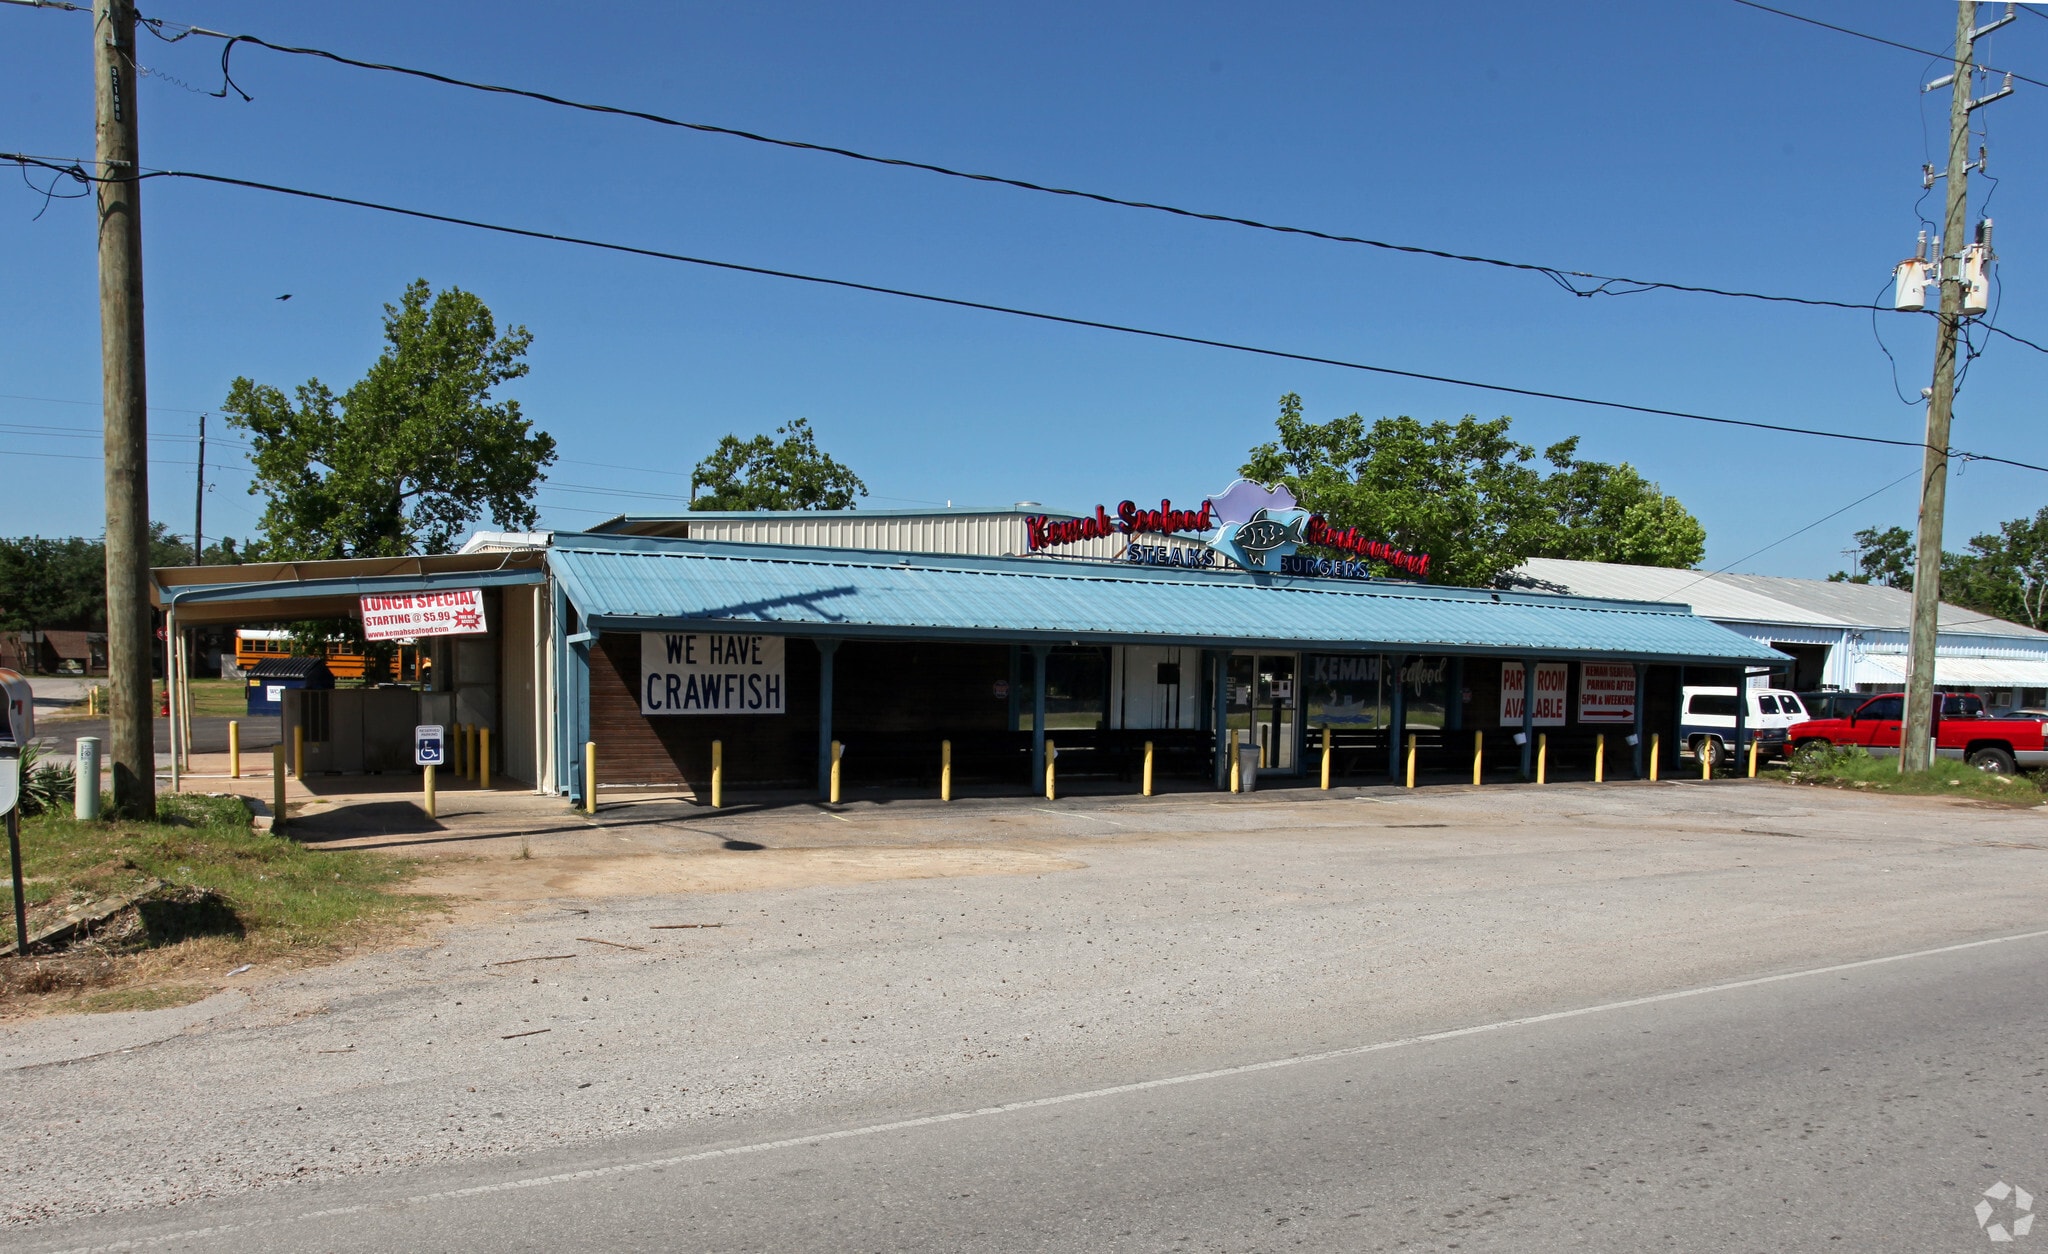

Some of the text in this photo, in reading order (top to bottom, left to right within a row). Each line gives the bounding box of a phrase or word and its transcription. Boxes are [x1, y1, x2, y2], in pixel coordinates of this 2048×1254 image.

[1025, 498, 1212, 551] Kemah Seafood
[1127, 543, 1216, 568] STEAKS
[1308, 513, 1431, 578] Restaurant
[1280, 555, 1370, 580] BURGERS
[363, 590, 477, 612] LUNCH SPECIAL
[366, 611, 451, 627] STARTING @ $5.99
[367, 626, 449, 639] www.kemahseafood.com
[665, 634, 763, 665] WE HAVE
[1314, 656, 1380, 681] KEMAH
[1585, 665, 1608, 677] KEMAH
[647, 672, 780, 710] CRAWFISH
[1537, 670, 1566, 691] ROOM
[1586, 679, 1634, 691] PARKING AFTER
[1581, 693, 1597, 705] 5PM
[1598, 696, 1604, 705] &
